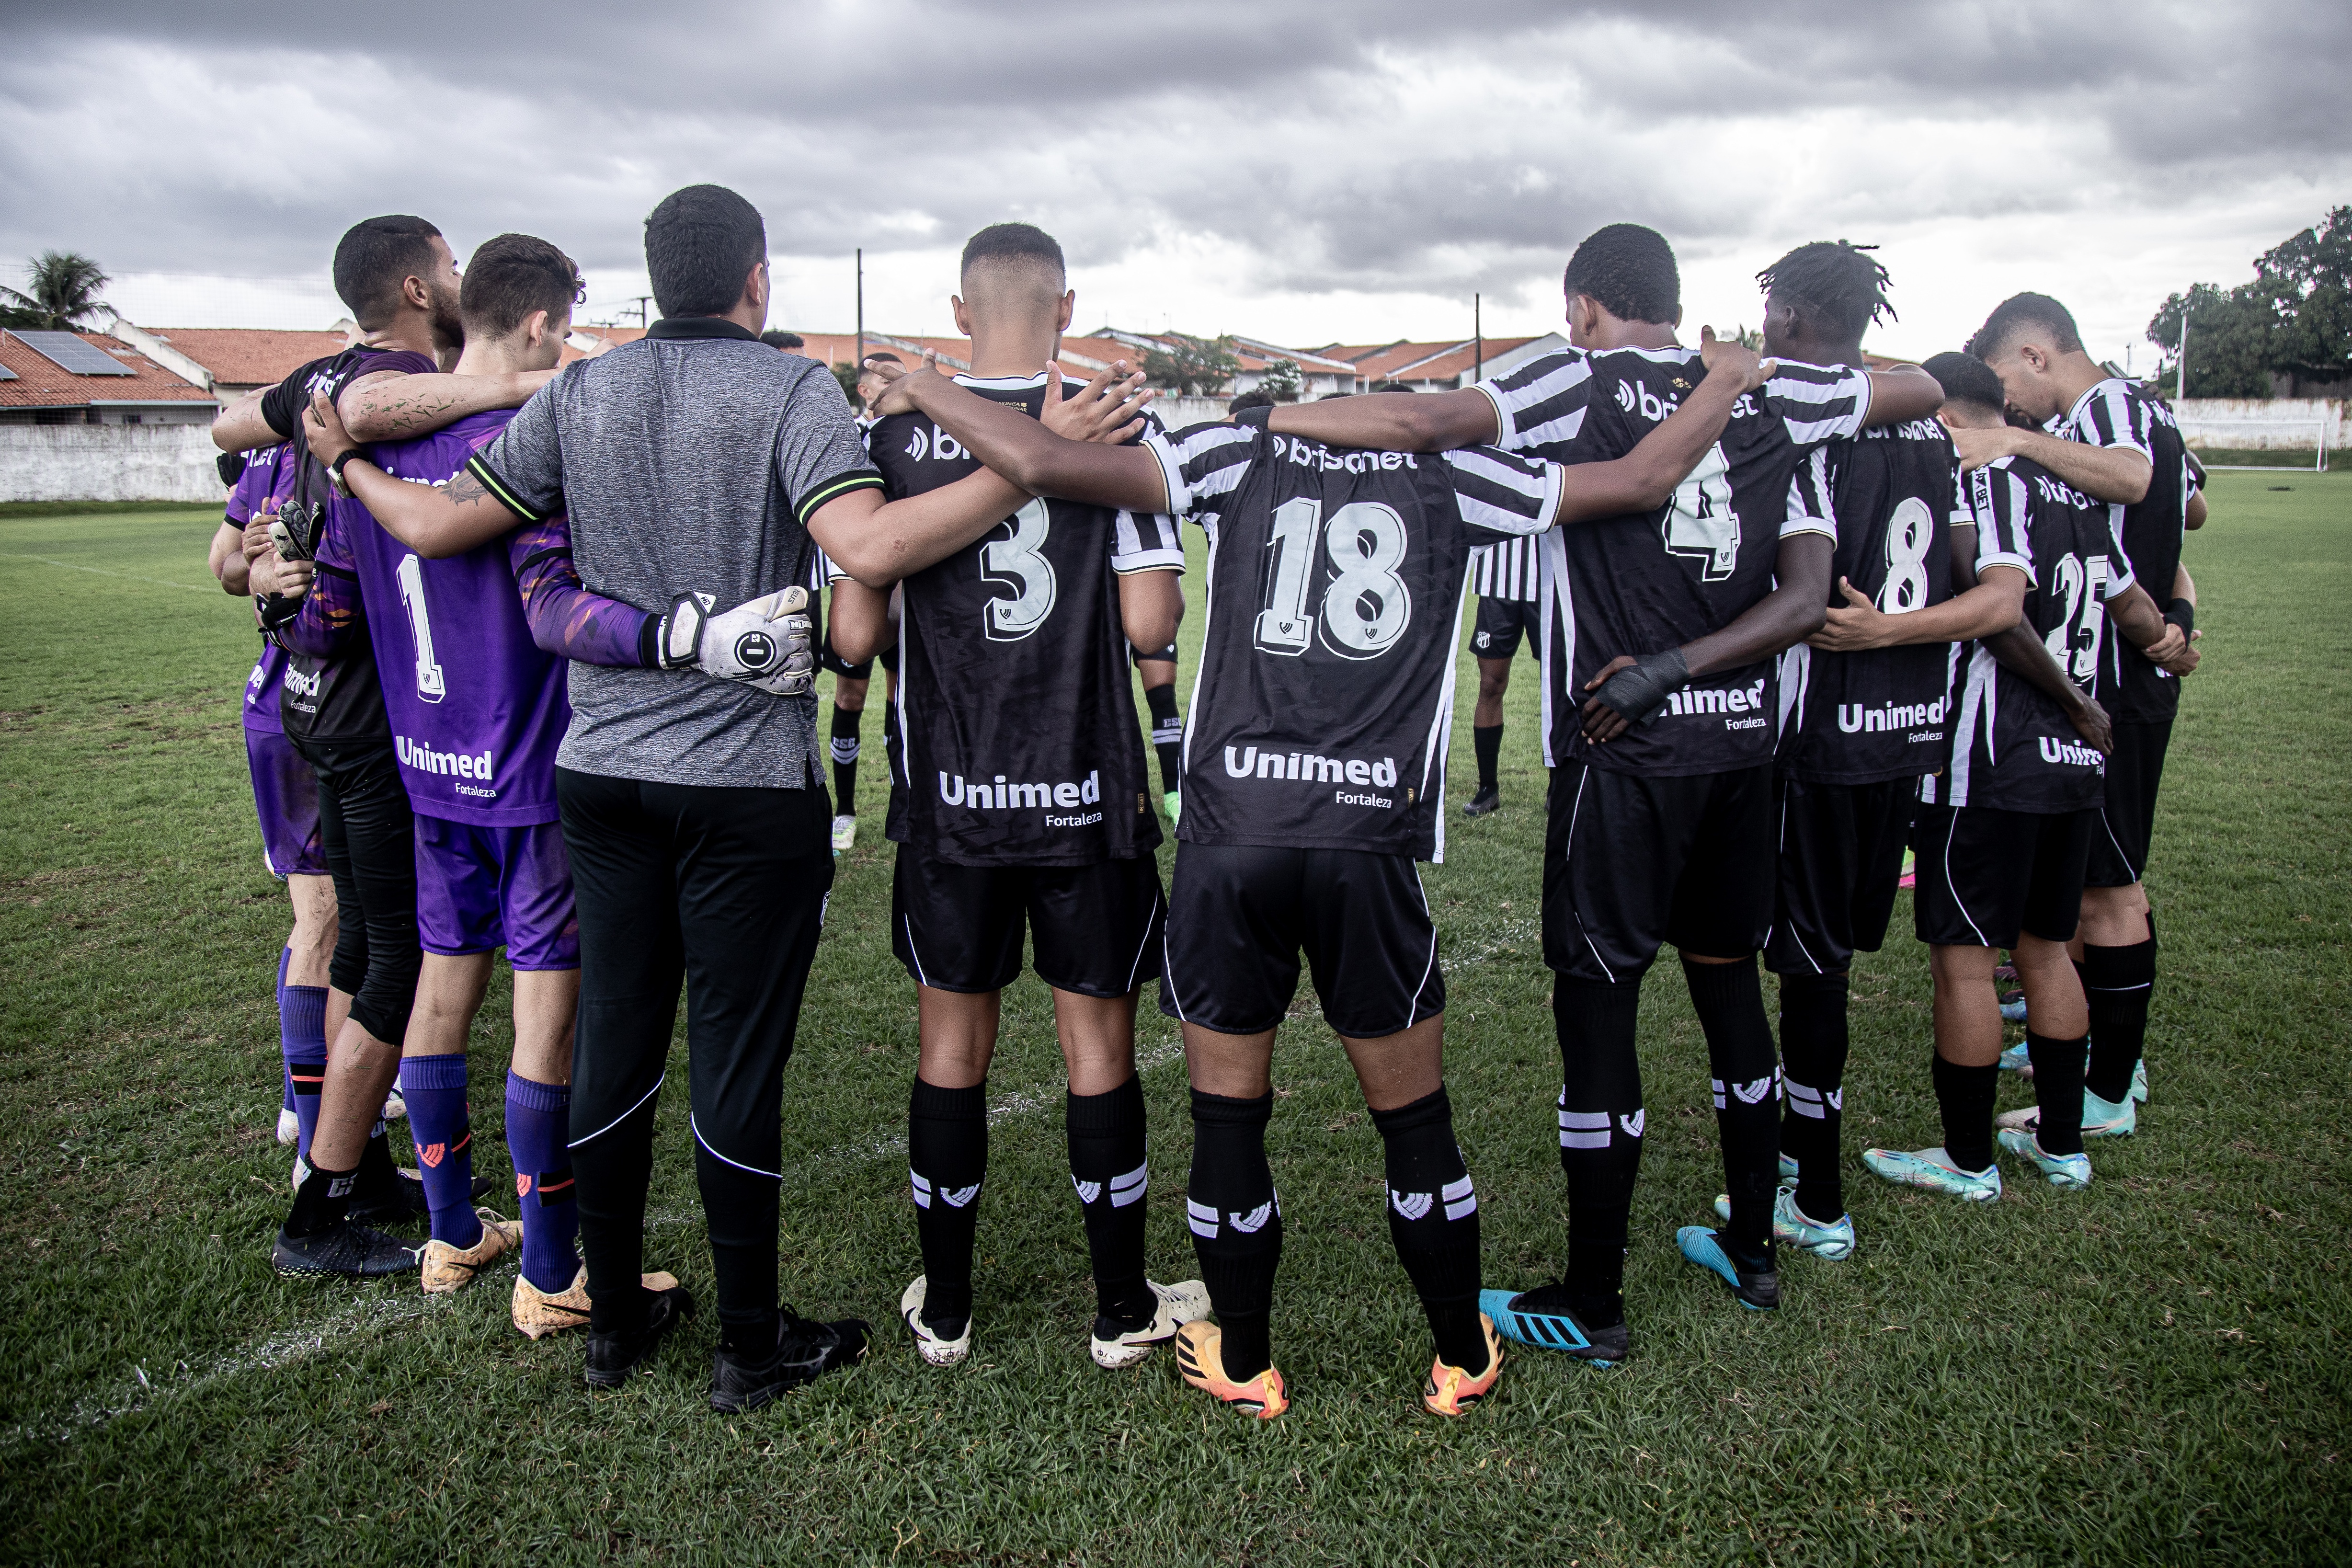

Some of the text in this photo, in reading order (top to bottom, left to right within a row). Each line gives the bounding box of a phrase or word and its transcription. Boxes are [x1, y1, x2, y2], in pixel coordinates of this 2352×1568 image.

[1289, 437, 1418, 475] brisanet
[1662, 440, 1741, 582] 4
[980, 497, 1057, 642] 3
[1875, 497, 1933, 615] 8
[1254, 497, 1411, 661] 18
[396, 553, 446, 704] 1
[2042, 552, 2108, 686] 25
[1659, 678, 1765, 717] nimed
[1838, 696, 1945, 733] Unimed
[1725, 716, 1767, 731] Fortaleza
[1908, 731, 1943, 744] Fortaleza
[396, 736, 492, 780] Unimed
[1224, 745, 1398, 788] Unimed
[455, 782, 496, 797] Fortaleza
[939, 770, 1101, 809] Unimed
[1336, 791, 1392, 809] Fortaleza
[1045, 811, 1103, 827] Fortaleza
